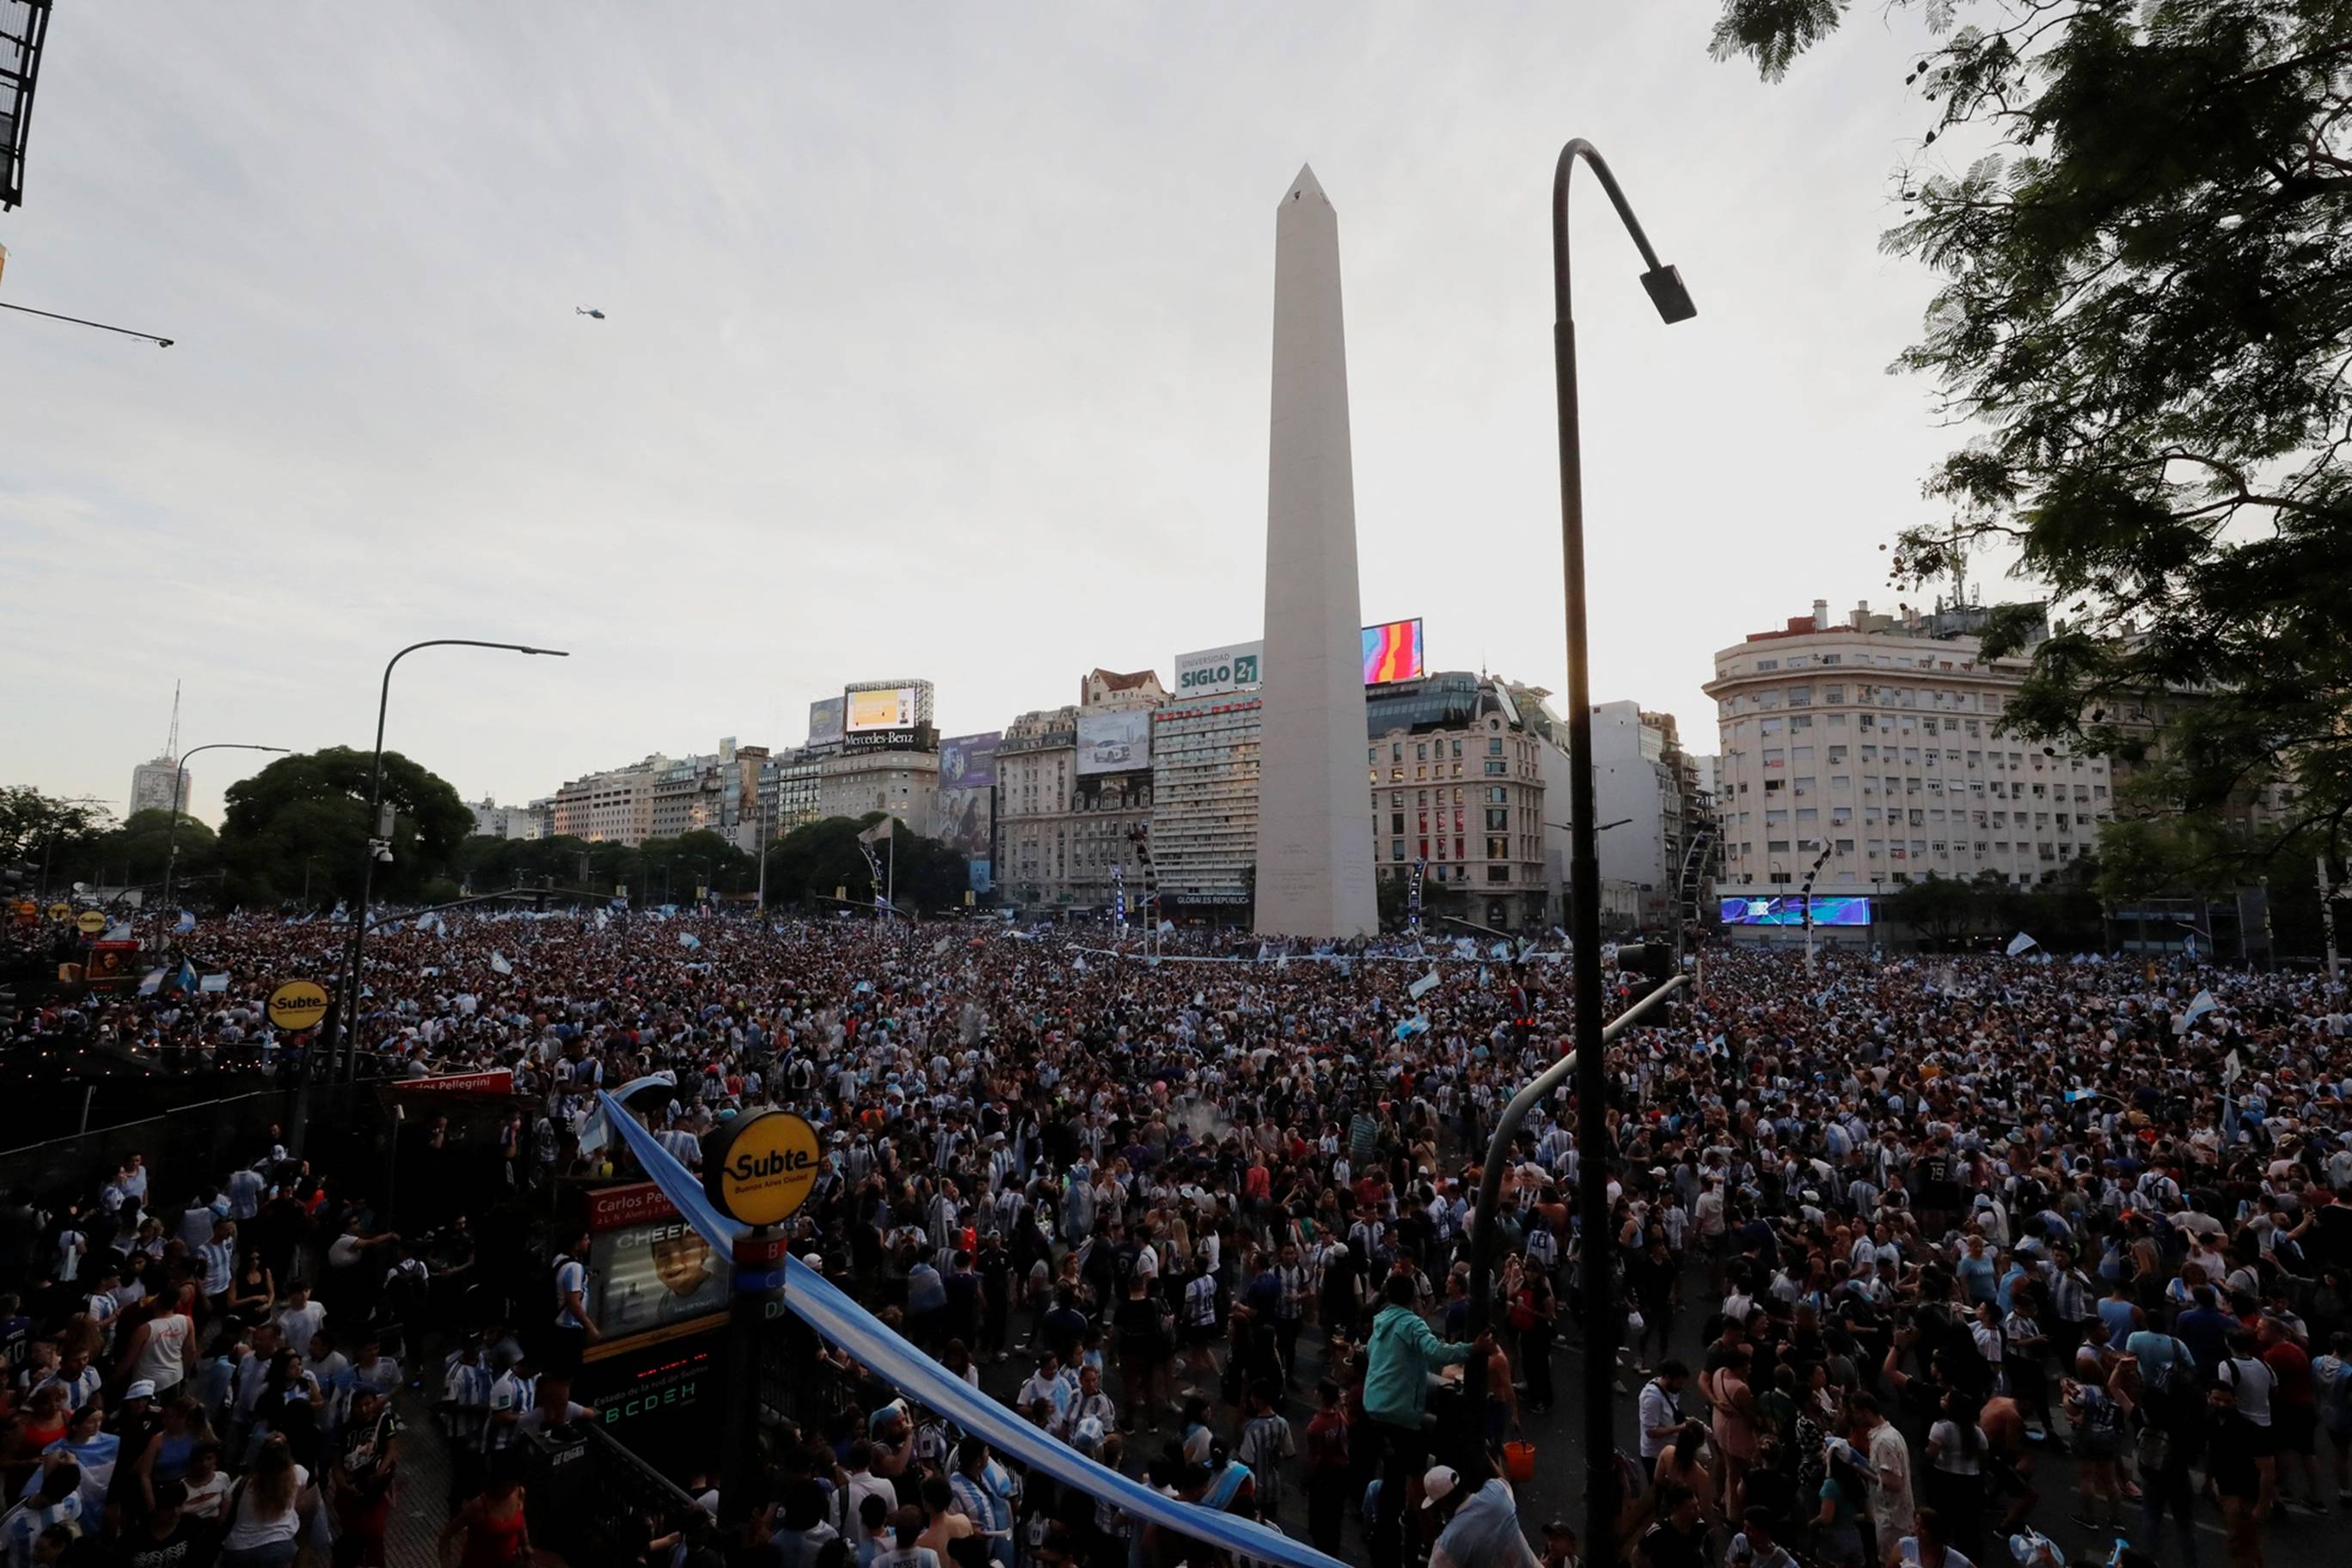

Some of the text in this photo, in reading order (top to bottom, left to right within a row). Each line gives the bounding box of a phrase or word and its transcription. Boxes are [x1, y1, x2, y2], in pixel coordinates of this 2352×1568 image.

[1181, 653, 1230, 668] UNIVERSIDAD
[1181, 661, 1254, 689] SIGLO 21
[845, 732, 914, 745] Mercedes-Benz
[1176, 896, 1211, 904] GLOBALES
[276, 996, 322, 1010] Subte
[438, 1075, 492, 1091] Pellegrini
[734, 1148, 812, 1181] Subte
[734, 1183, 763, 1194] Buenos
[764, 1178, 782, 1189] Aires
[597, 1195, 642, 1213] Carlos
[768, 1242, 779, 1259] B
[765, 1271, 777, 1289] C
[764, 1301, 777, 1319] D
[593, 1391, 627, 1407] Estado
[628, 1387, 640, 1397] de
[640, 1381, 651, 1392] la
[651, 1376, 667, 1389] red
[605, 1406, 620, 1424] B
[625, 1400, 640, 1417] C
[645, 1393, 658, 1411] D
[663, 1387, 677, 1405] E
[681, 1381, 695, 1399] H
